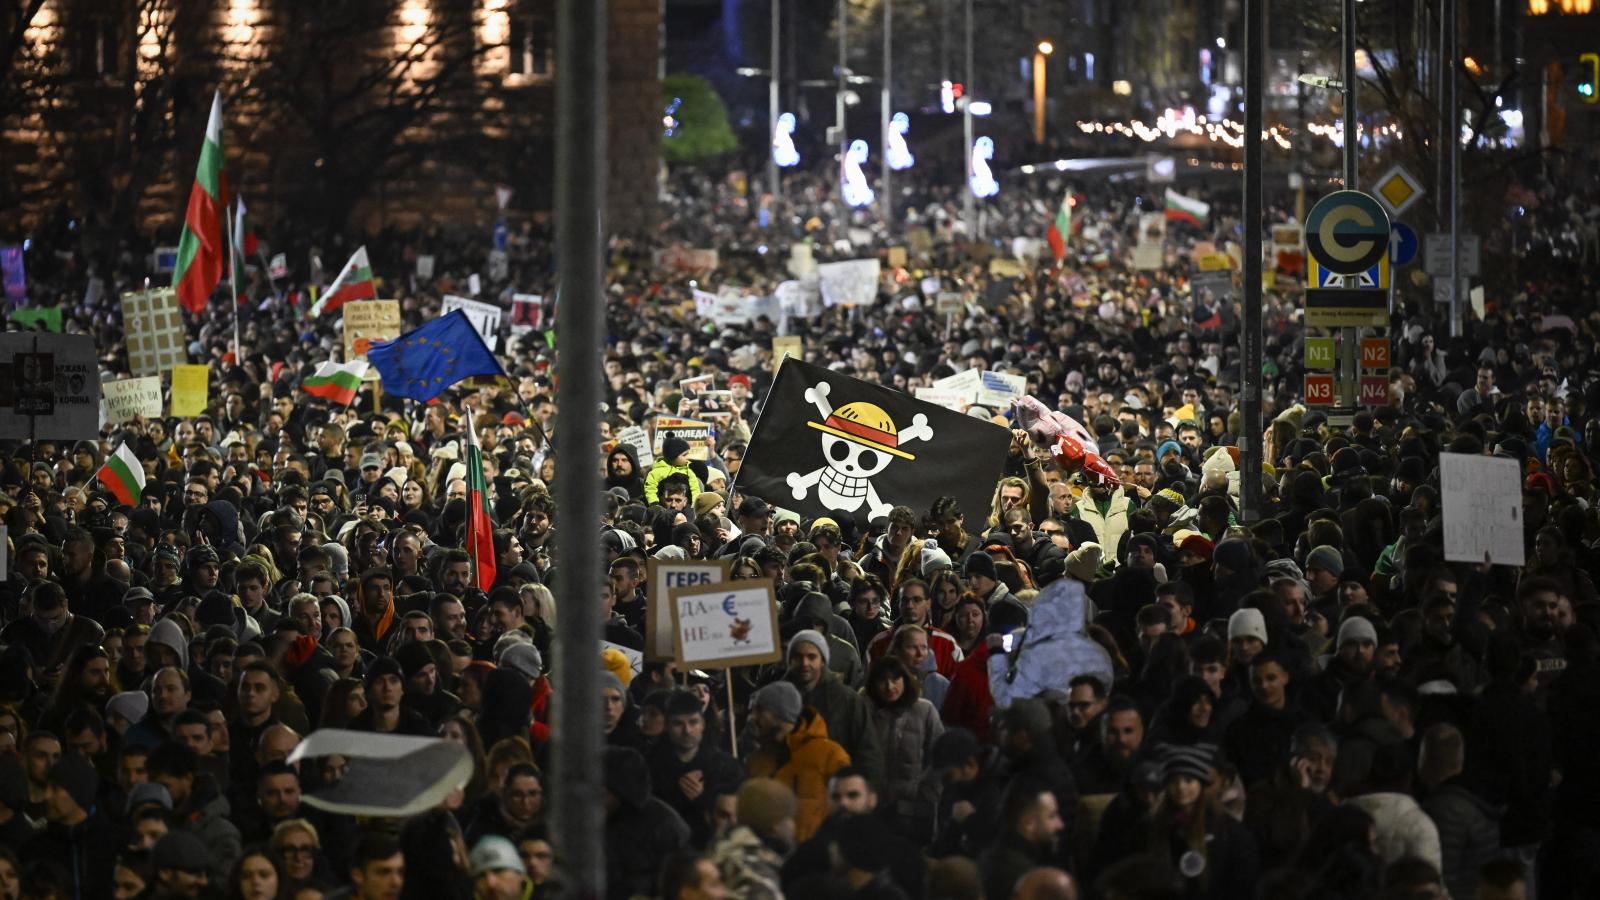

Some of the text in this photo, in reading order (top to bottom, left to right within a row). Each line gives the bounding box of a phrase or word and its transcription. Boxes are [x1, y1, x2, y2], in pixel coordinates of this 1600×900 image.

[1309, 346, 1330, 361] N1
[1364, 346, 1386, 361] N2
[1308, 384, 1330, 398] N3
[1363, 384, 1386, 398] N4
[666, 572, 711, 587] ГЕРБ
[681, 600, 708, 618] ДА
[685, 626, 710, 643] НЕ
